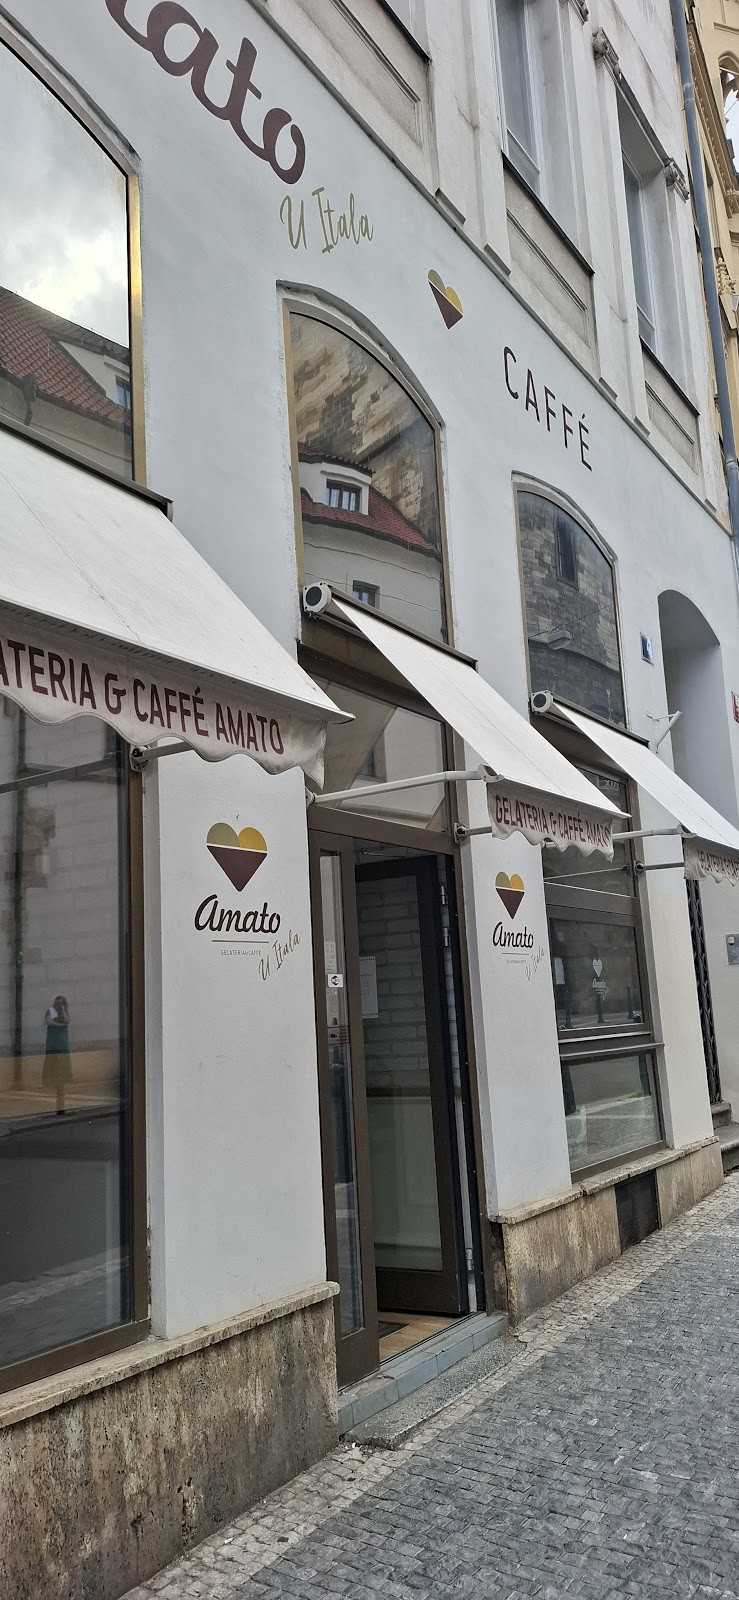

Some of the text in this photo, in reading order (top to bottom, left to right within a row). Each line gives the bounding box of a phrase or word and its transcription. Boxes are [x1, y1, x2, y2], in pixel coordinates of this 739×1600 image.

[106, 0, 305, 184] ato
[280, 187, 374, 253] U Itala
[503, 346, 592, 472] CAFFÉ
[104, 673, 126, 715] &
[133, 677, 209, 737] CAFFÉ
[215, 702, 285, 755] AMATO
[495, 795, 549, 834] GELATERIA
[557, 810, 586, 842] CAFFÉ
[194, 894, 281, 933] Amato
[492, 921, 534, 948] Amato
[258, 955, 271, 981] U
[272, 929, 301, 970] Itala
